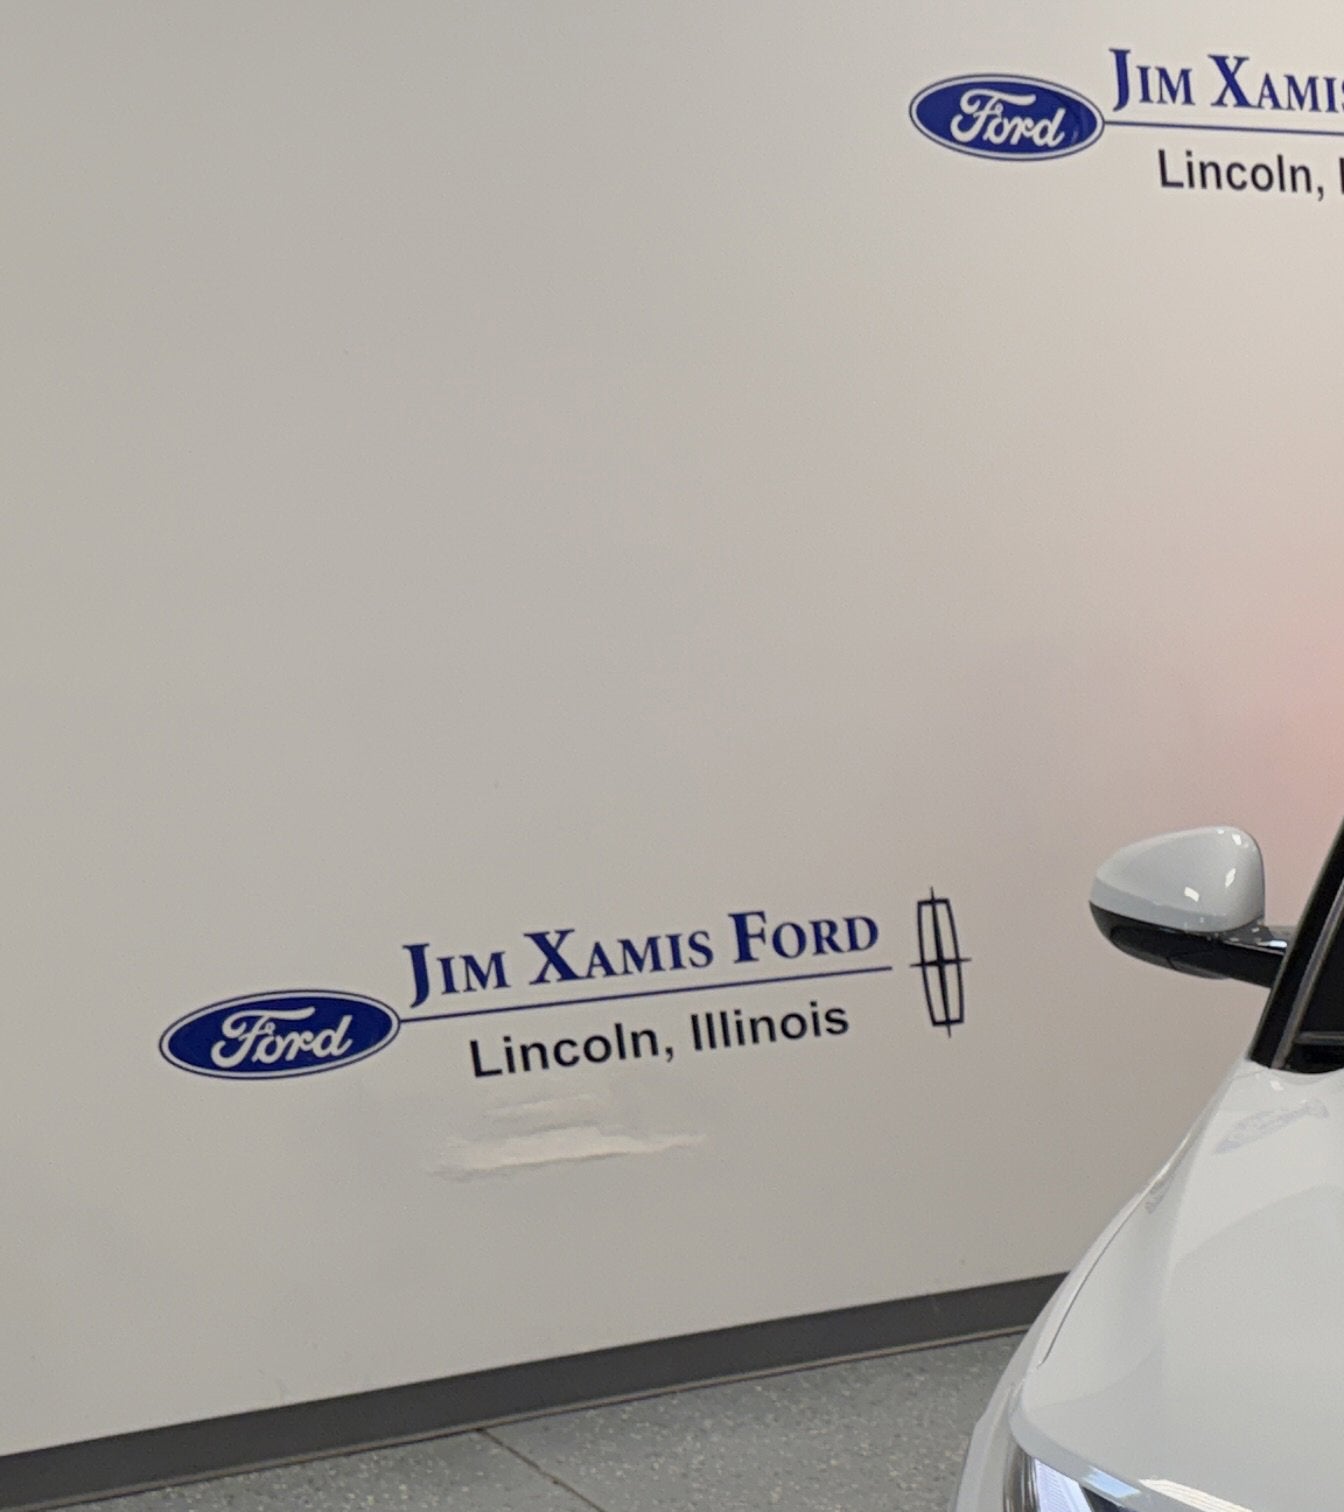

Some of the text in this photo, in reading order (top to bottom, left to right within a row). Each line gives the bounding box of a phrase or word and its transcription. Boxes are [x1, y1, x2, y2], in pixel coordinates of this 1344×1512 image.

[1108, 47, 1196, 113] JIM
[949, 87, 1066, 149] Ford
[1157, 148, 1325, 202] Lincoln,
[401, 910, 879, 1009] JIM XAMIS FORD
[210, 1006, 353, 1069] Ford
[469, 1000, 850, 1079] Lincoln, Illinois
